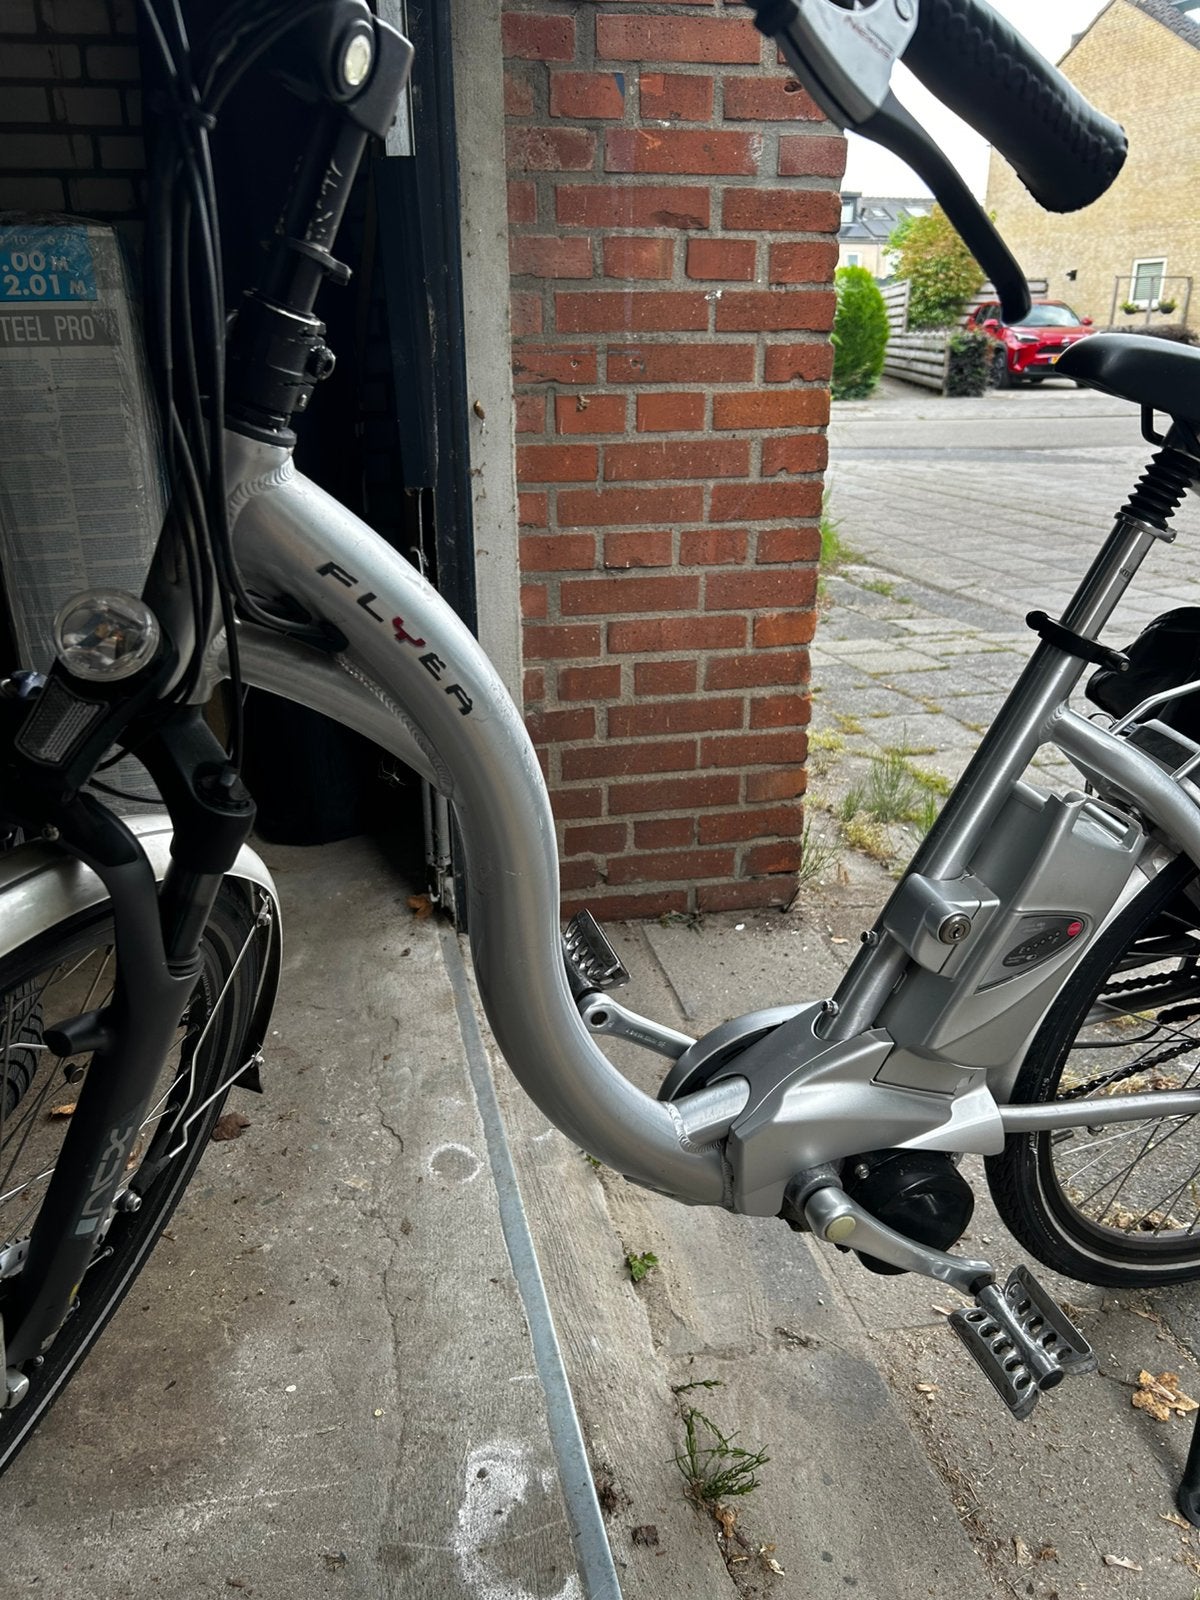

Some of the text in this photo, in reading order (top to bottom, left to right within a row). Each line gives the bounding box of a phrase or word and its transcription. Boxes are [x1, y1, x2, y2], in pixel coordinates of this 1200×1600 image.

[3, 274, 88, 296] 2.01 M
[55, 315, 95, 341] PRO
[316, 561, 473, 716] FLYER
